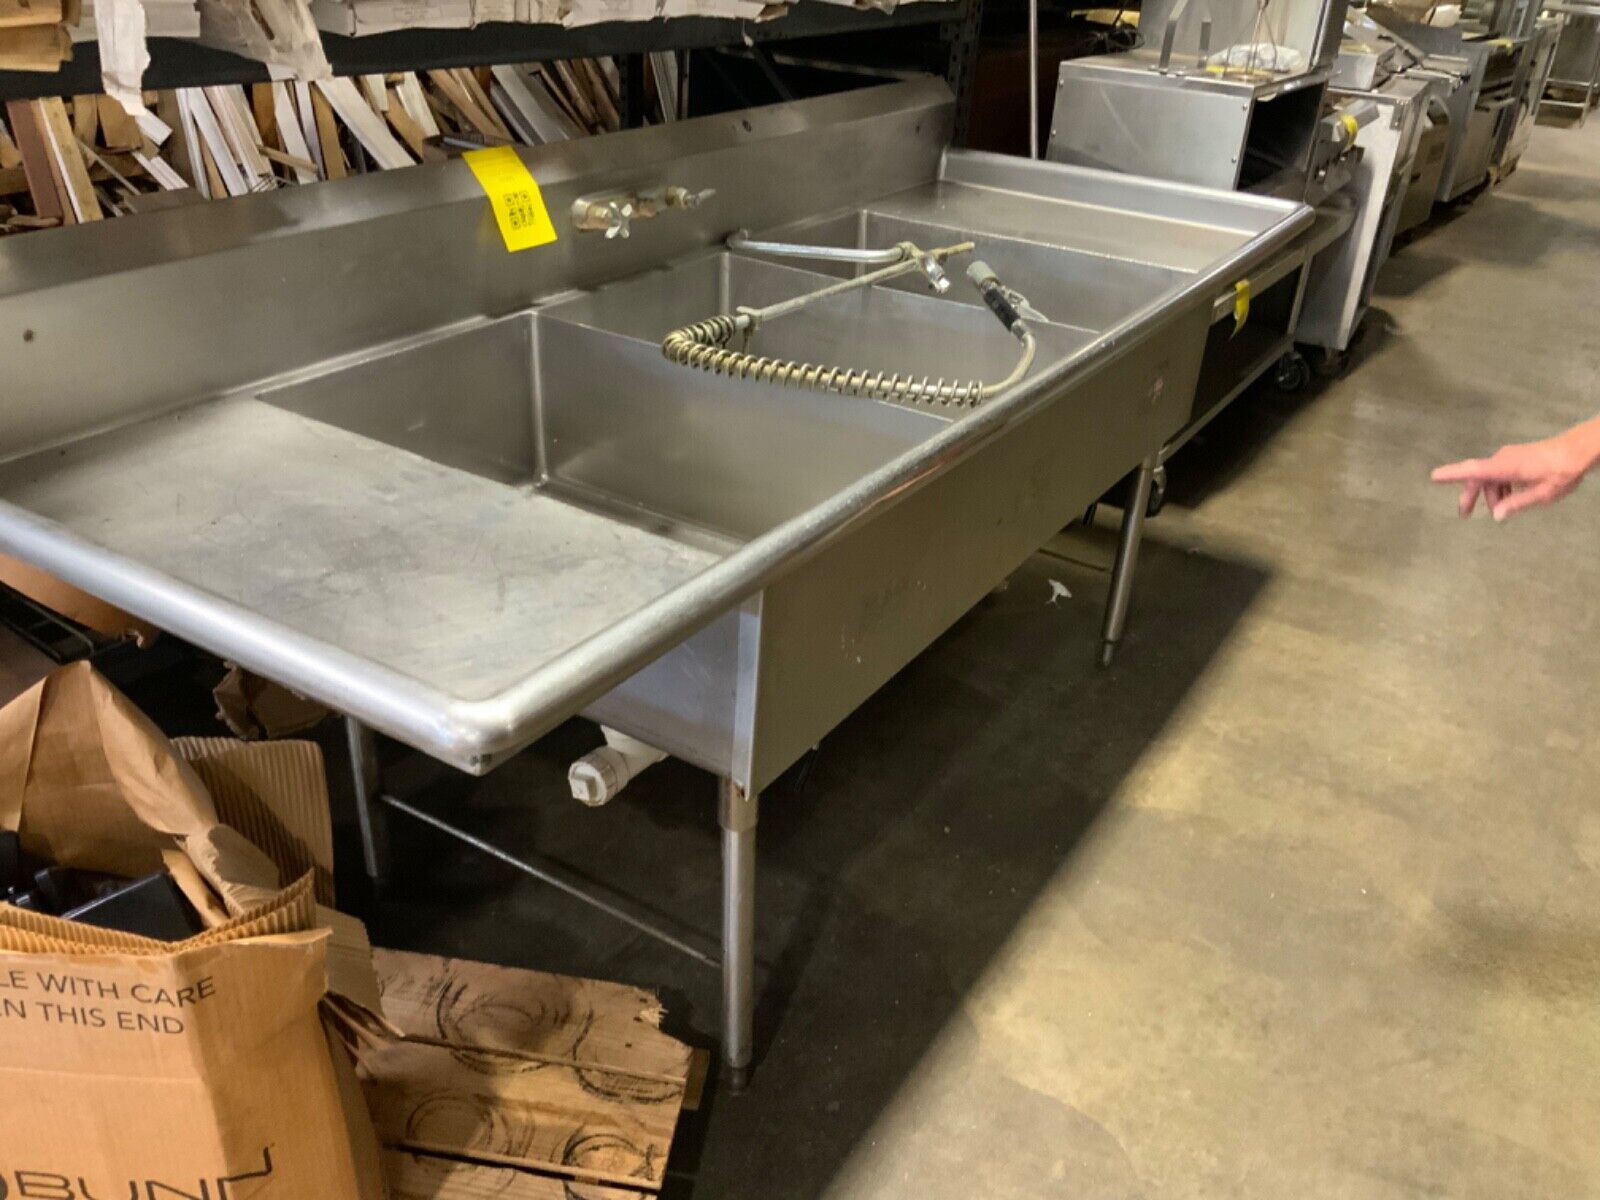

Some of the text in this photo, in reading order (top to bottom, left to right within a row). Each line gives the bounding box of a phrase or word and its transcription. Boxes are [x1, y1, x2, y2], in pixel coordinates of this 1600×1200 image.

[36, 972, 119, 999] WITH
[130, 976, 216, 1008] CARE
[35, 1001, 106, 1028] THIS
[117, 1011, 184, 1034] END
